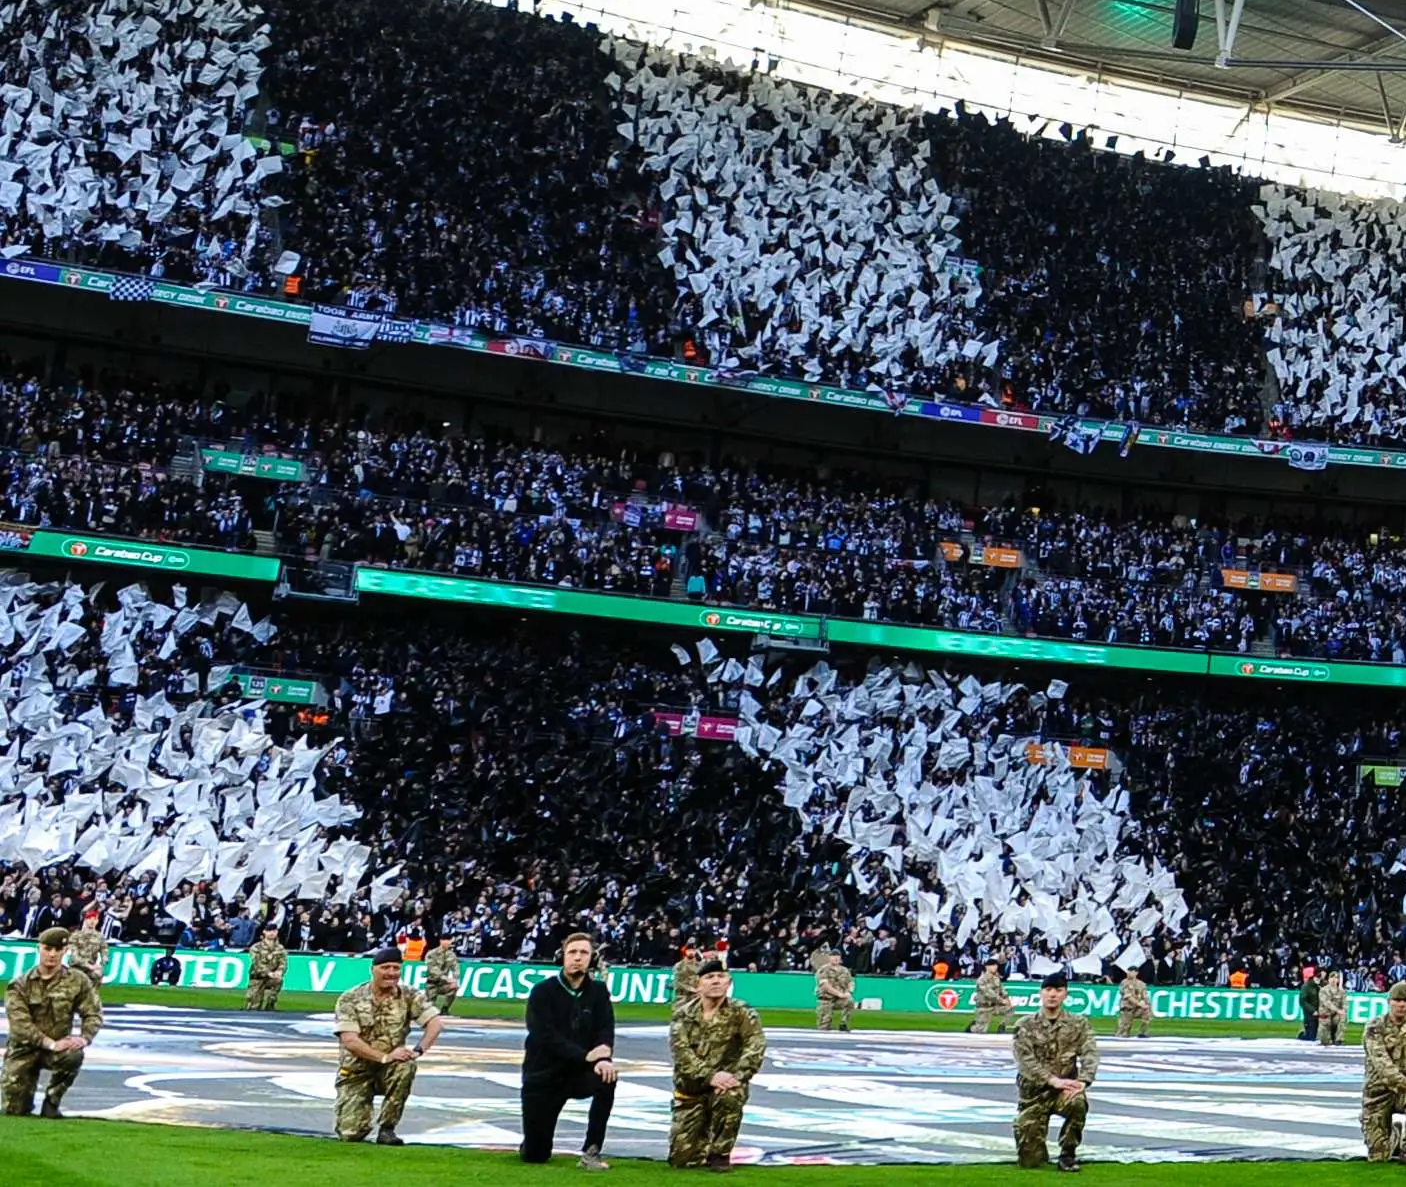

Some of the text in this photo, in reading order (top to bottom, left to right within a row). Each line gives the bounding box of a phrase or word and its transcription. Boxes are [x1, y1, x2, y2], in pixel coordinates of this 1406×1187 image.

[94, 546, 164, 564] Carabao Cup
[309, 965, 335, 998] V
[1086, 989, 1274, 1019] MACHESTER
